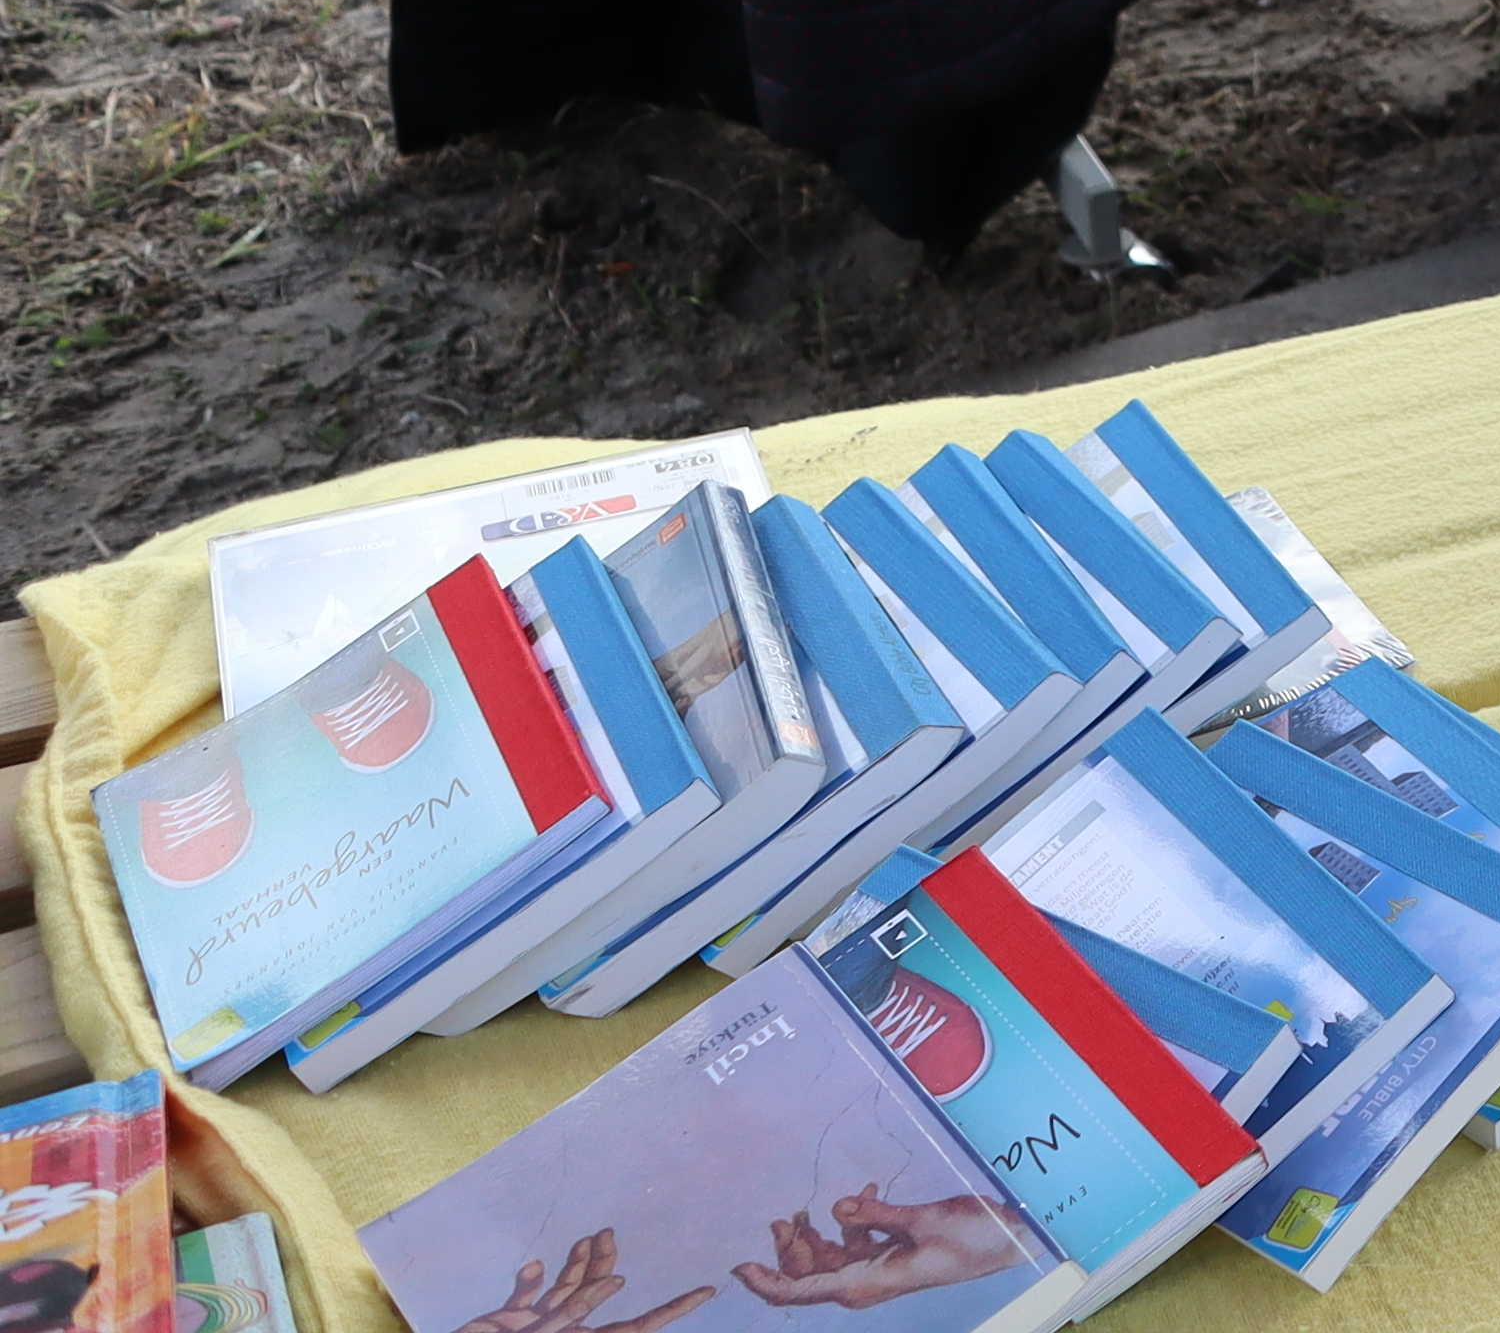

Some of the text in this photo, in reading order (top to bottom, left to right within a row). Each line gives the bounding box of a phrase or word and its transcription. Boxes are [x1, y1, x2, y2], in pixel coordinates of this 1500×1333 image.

[509, 502, 606, 532] V&D
[186, 777, 471, 986] Waargebeurd
[358, 849, 394, 879] EEN
[213, 863, 313, 927] VERHAAL
[325, 908, 359, 933] VAN
[683, 999, 778, 1066] Türkiye
[703, 1013, 797, 1086] İncil
[1404, 1035, 1438, 1075] CITY
[1357, 1073, 1406, 1123] BIBLE
[1043, 1185, 1088, 1225] EVAN
